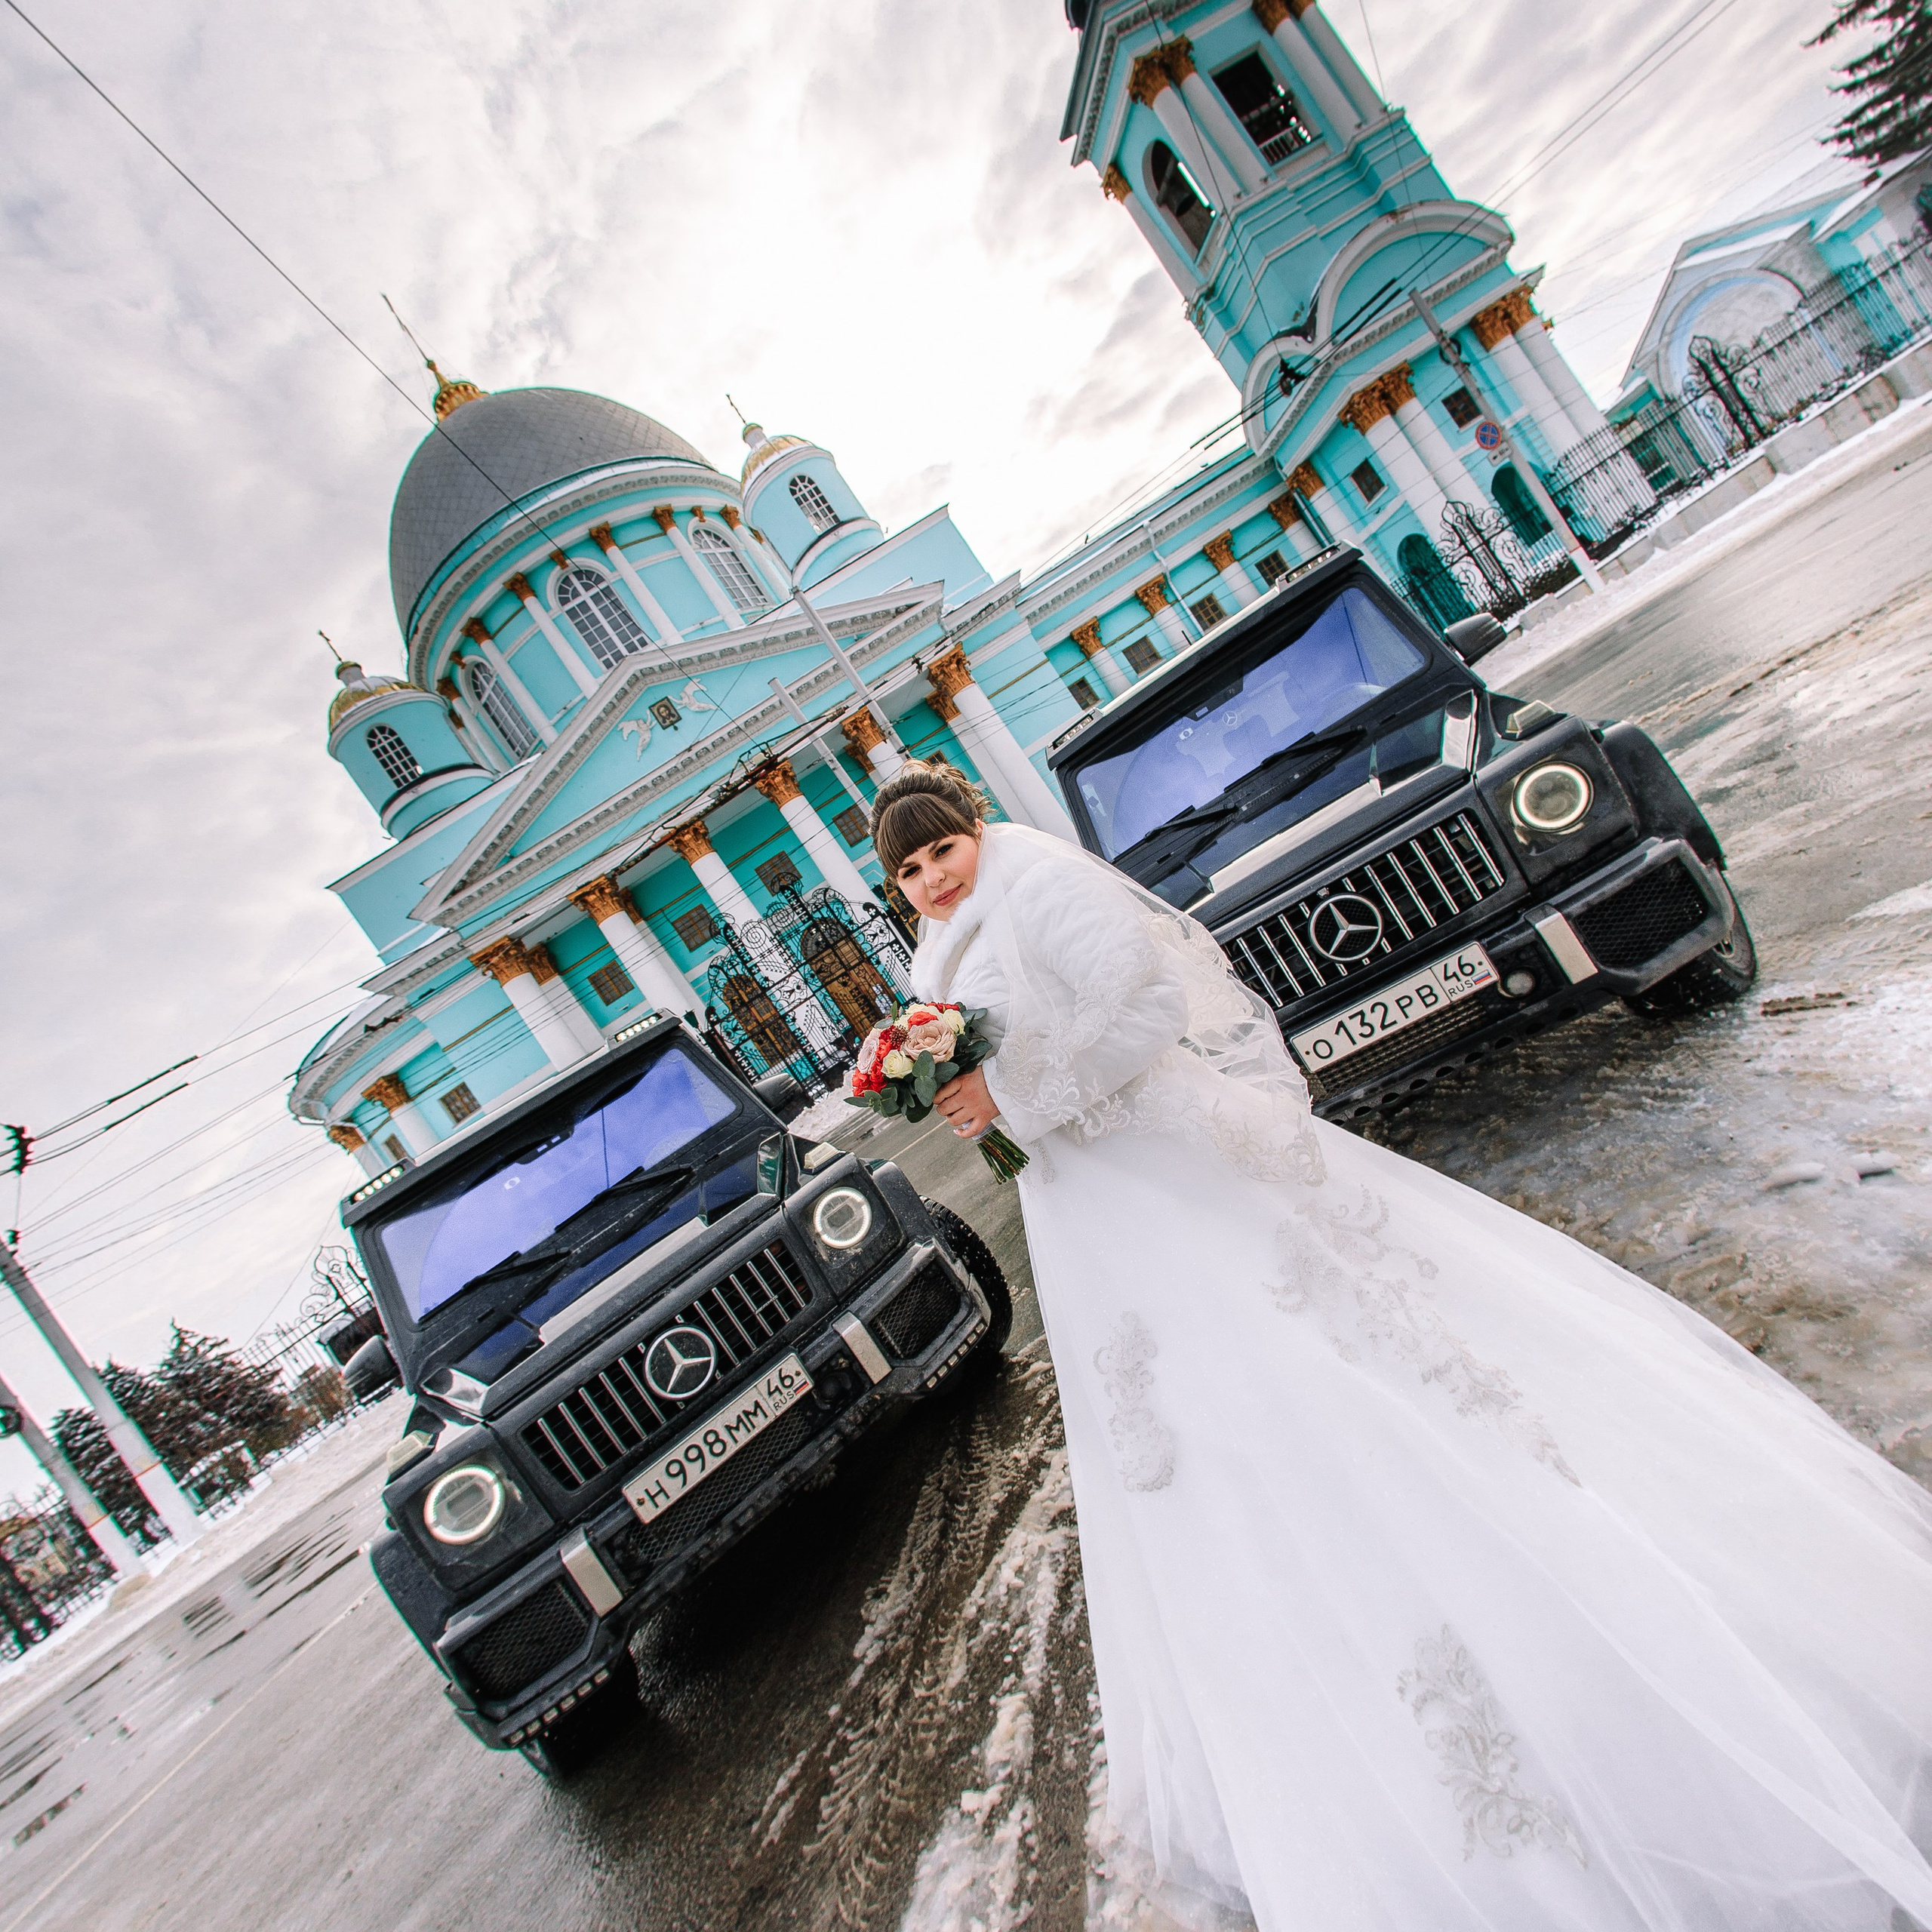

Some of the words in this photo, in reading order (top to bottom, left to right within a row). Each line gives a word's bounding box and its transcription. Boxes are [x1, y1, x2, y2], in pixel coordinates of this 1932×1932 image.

[1442, 954, 1476, 983] 46
[1448, 979, 1473, 998] RUS
[767, 1367, 795, 1398] 46
[773, 1390, 795, 1411] RUS
